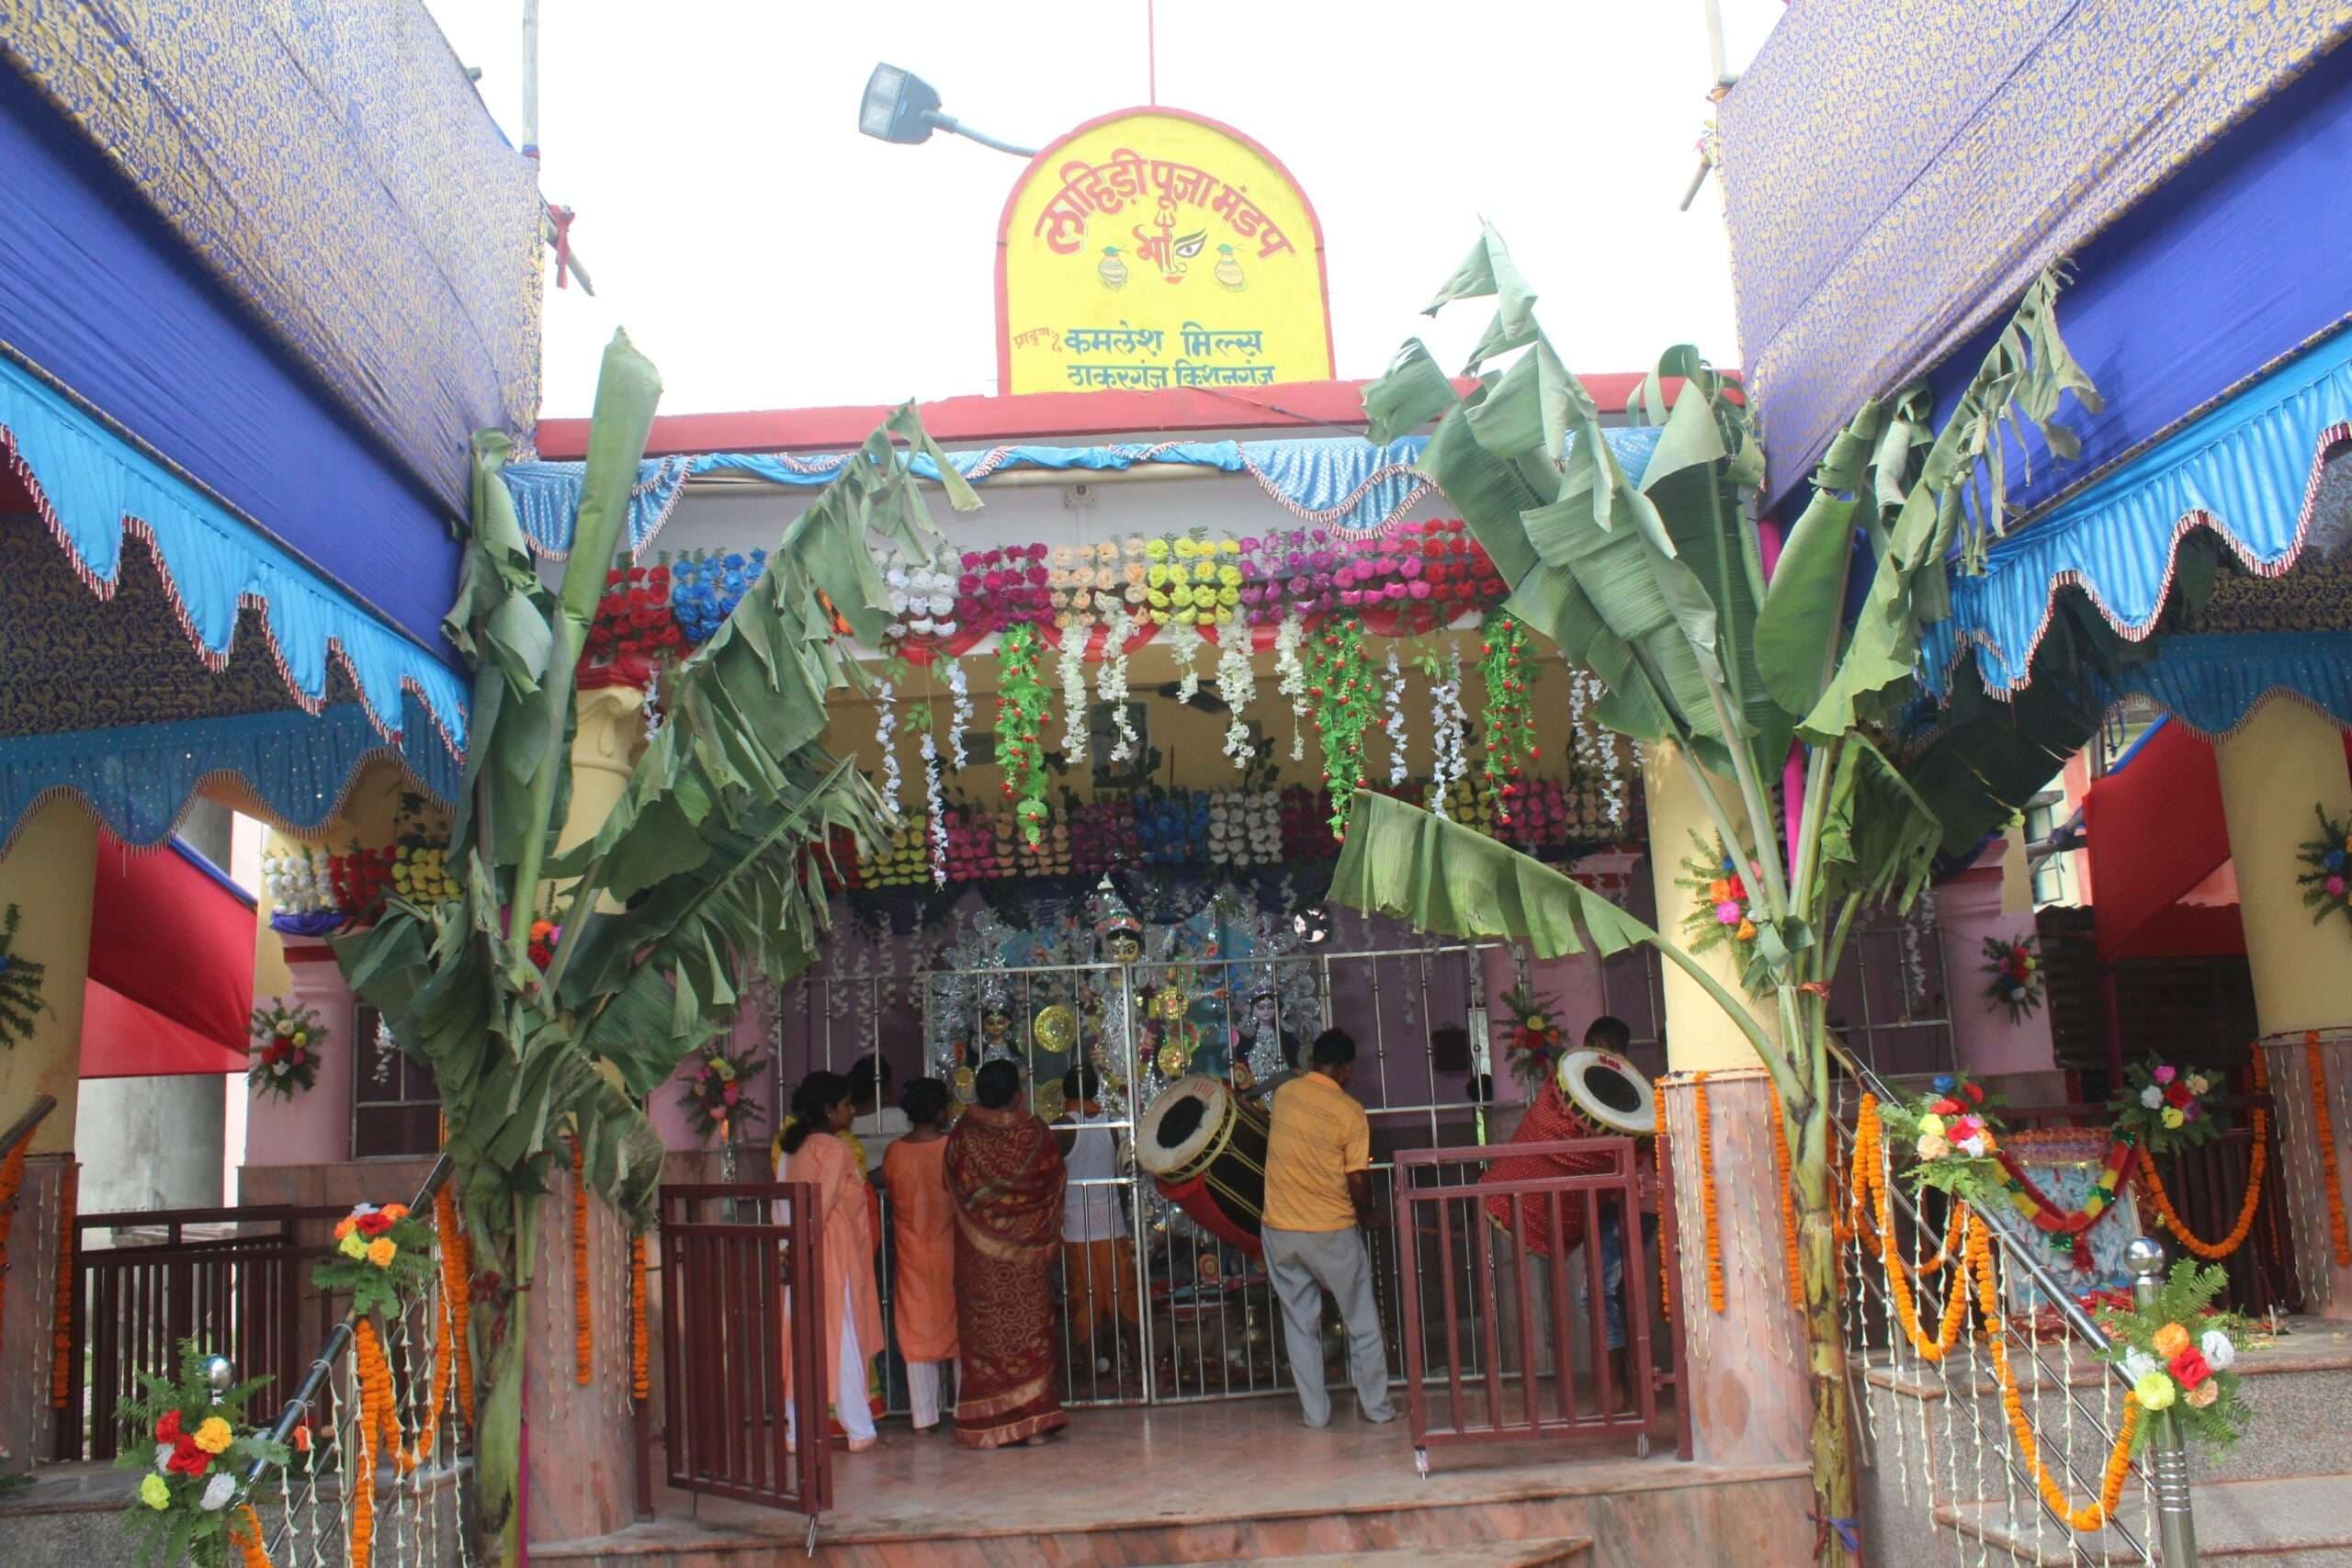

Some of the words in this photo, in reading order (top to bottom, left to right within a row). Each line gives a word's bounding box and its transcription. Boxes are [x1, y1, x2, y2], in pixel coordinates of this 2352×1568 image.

[1150, 160, 1220, 211] पूजा
[1212, 184, 1295, 258] मंडप
[1064, 320, 1165, 356] कमलेश
[1180, 321, 1262, 356] मिल्स
[1173, 359, 1275, 386] किशनगंज
